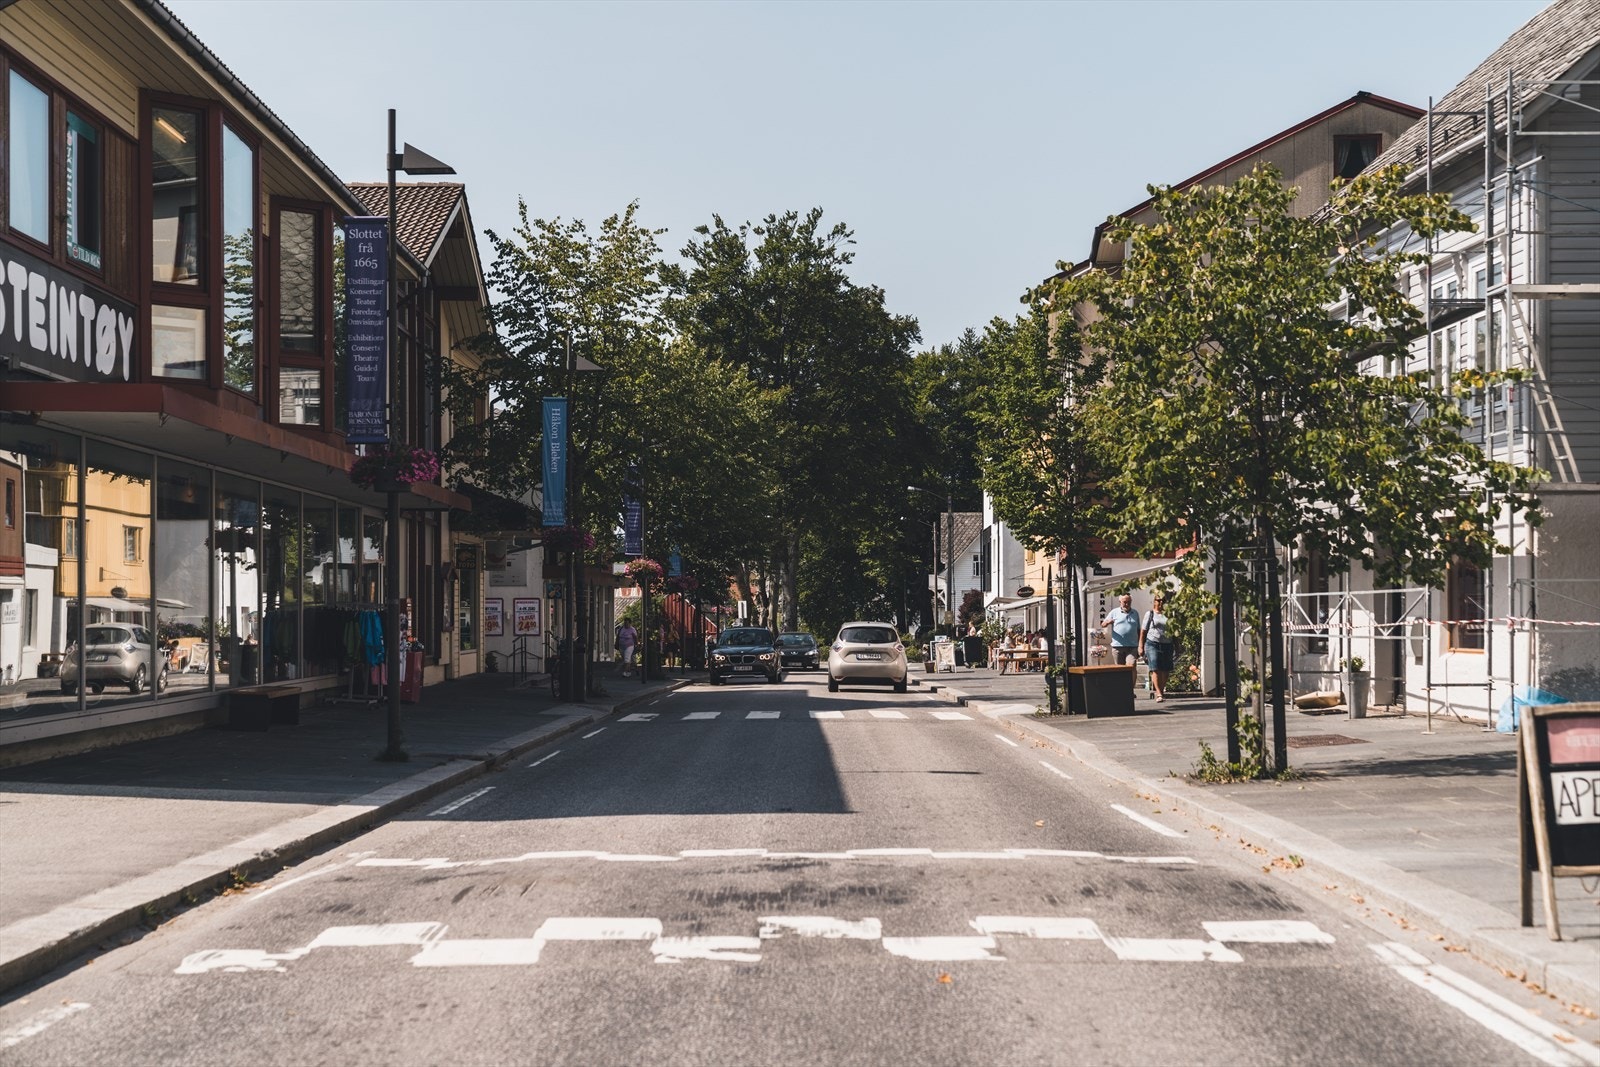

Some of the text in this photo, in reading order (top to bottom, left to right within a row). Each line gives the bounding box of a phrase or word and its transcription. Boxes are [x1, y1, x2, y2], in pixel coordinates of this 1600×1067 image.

[348, 228, 383, 239] Slottet
[358, 242, 373, 253] frå
[354, 257, 378, 269] 1665
[347, 278, 385, 286] Utstillingar
[349, 287, 382, 295] Konsertar
[347, 333, 384, 342] Exhibitions
[353, 354, 379, 362] Theatre
[354, 364, 378, 372] Guided
[356, 374, 376, 382] Tours
[348, 410, 384, 418] BARONIET
[551, 407, 562, 473] Håkon Bleken
